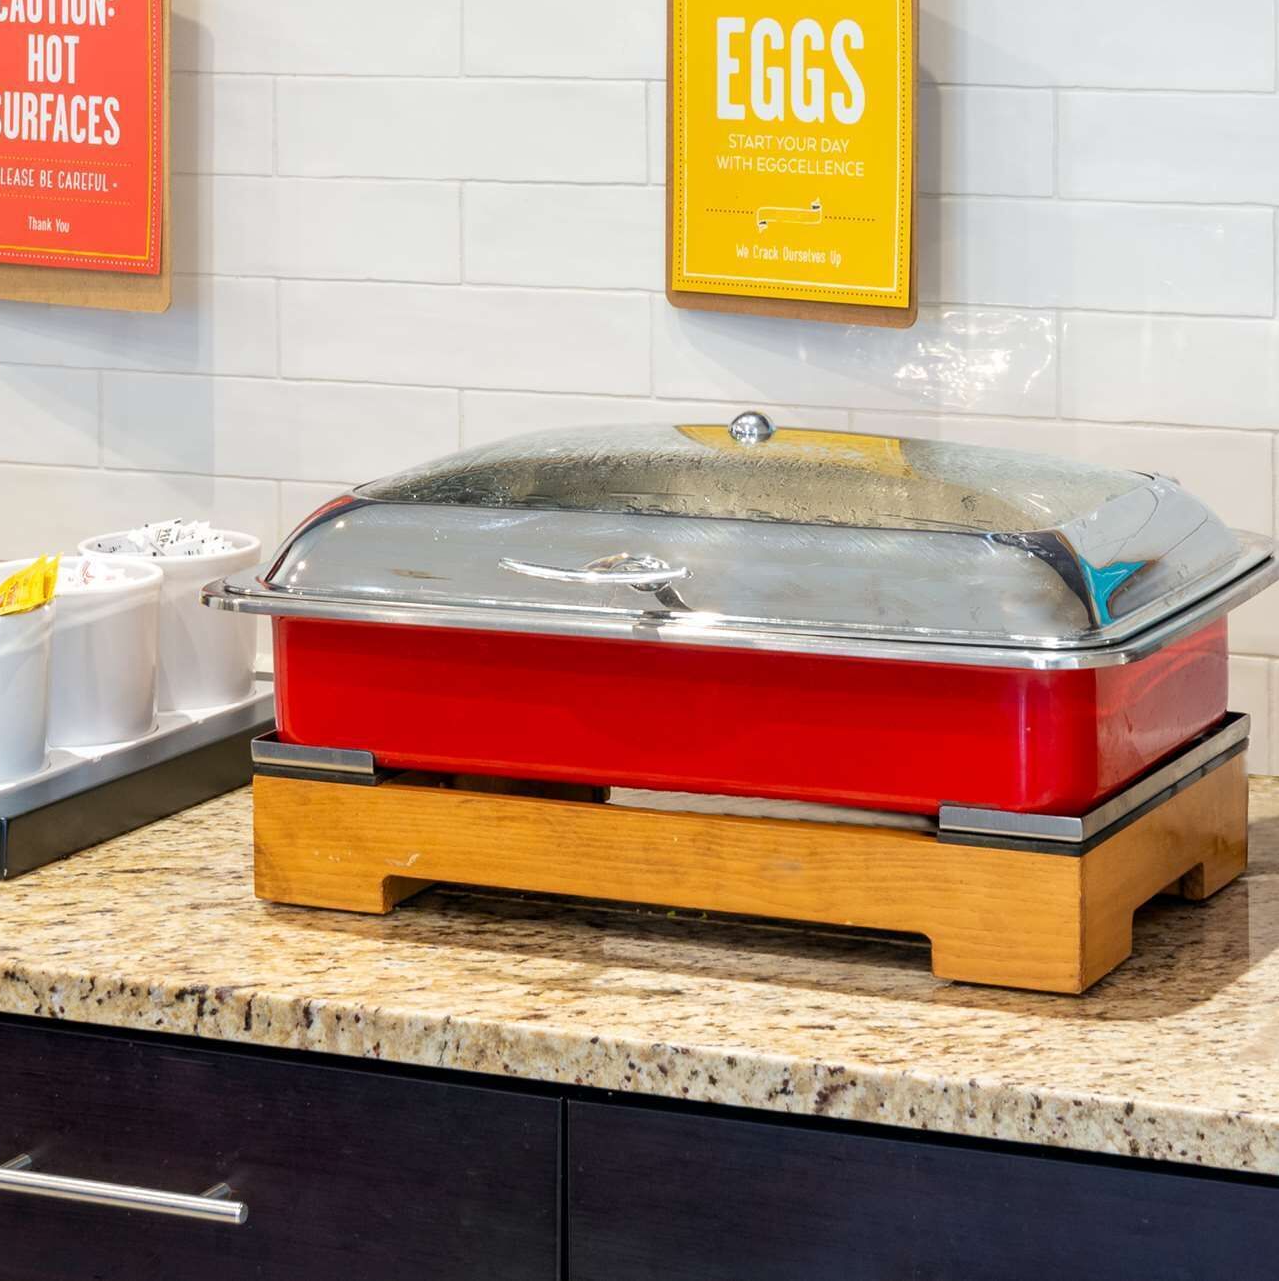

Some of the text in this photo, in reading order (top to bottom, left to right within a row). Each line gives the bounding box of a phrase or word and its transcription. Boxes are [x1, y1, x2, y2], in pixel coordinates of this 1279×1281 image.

[27, 34, 80, 85] HOT
[716, 16, 866, 125] EGGS
[728, 133, 850, 153] START YOUR DAY
[716, 155, 865, 177] WITH EGGCELLENCE
[40, 169, 53, 188] BE
[58, 170, 109, 192] CAREFUL
[28, 216, 70, 233] Thank You
[736, 244, 842, 268] We Crack Ourselves Up
